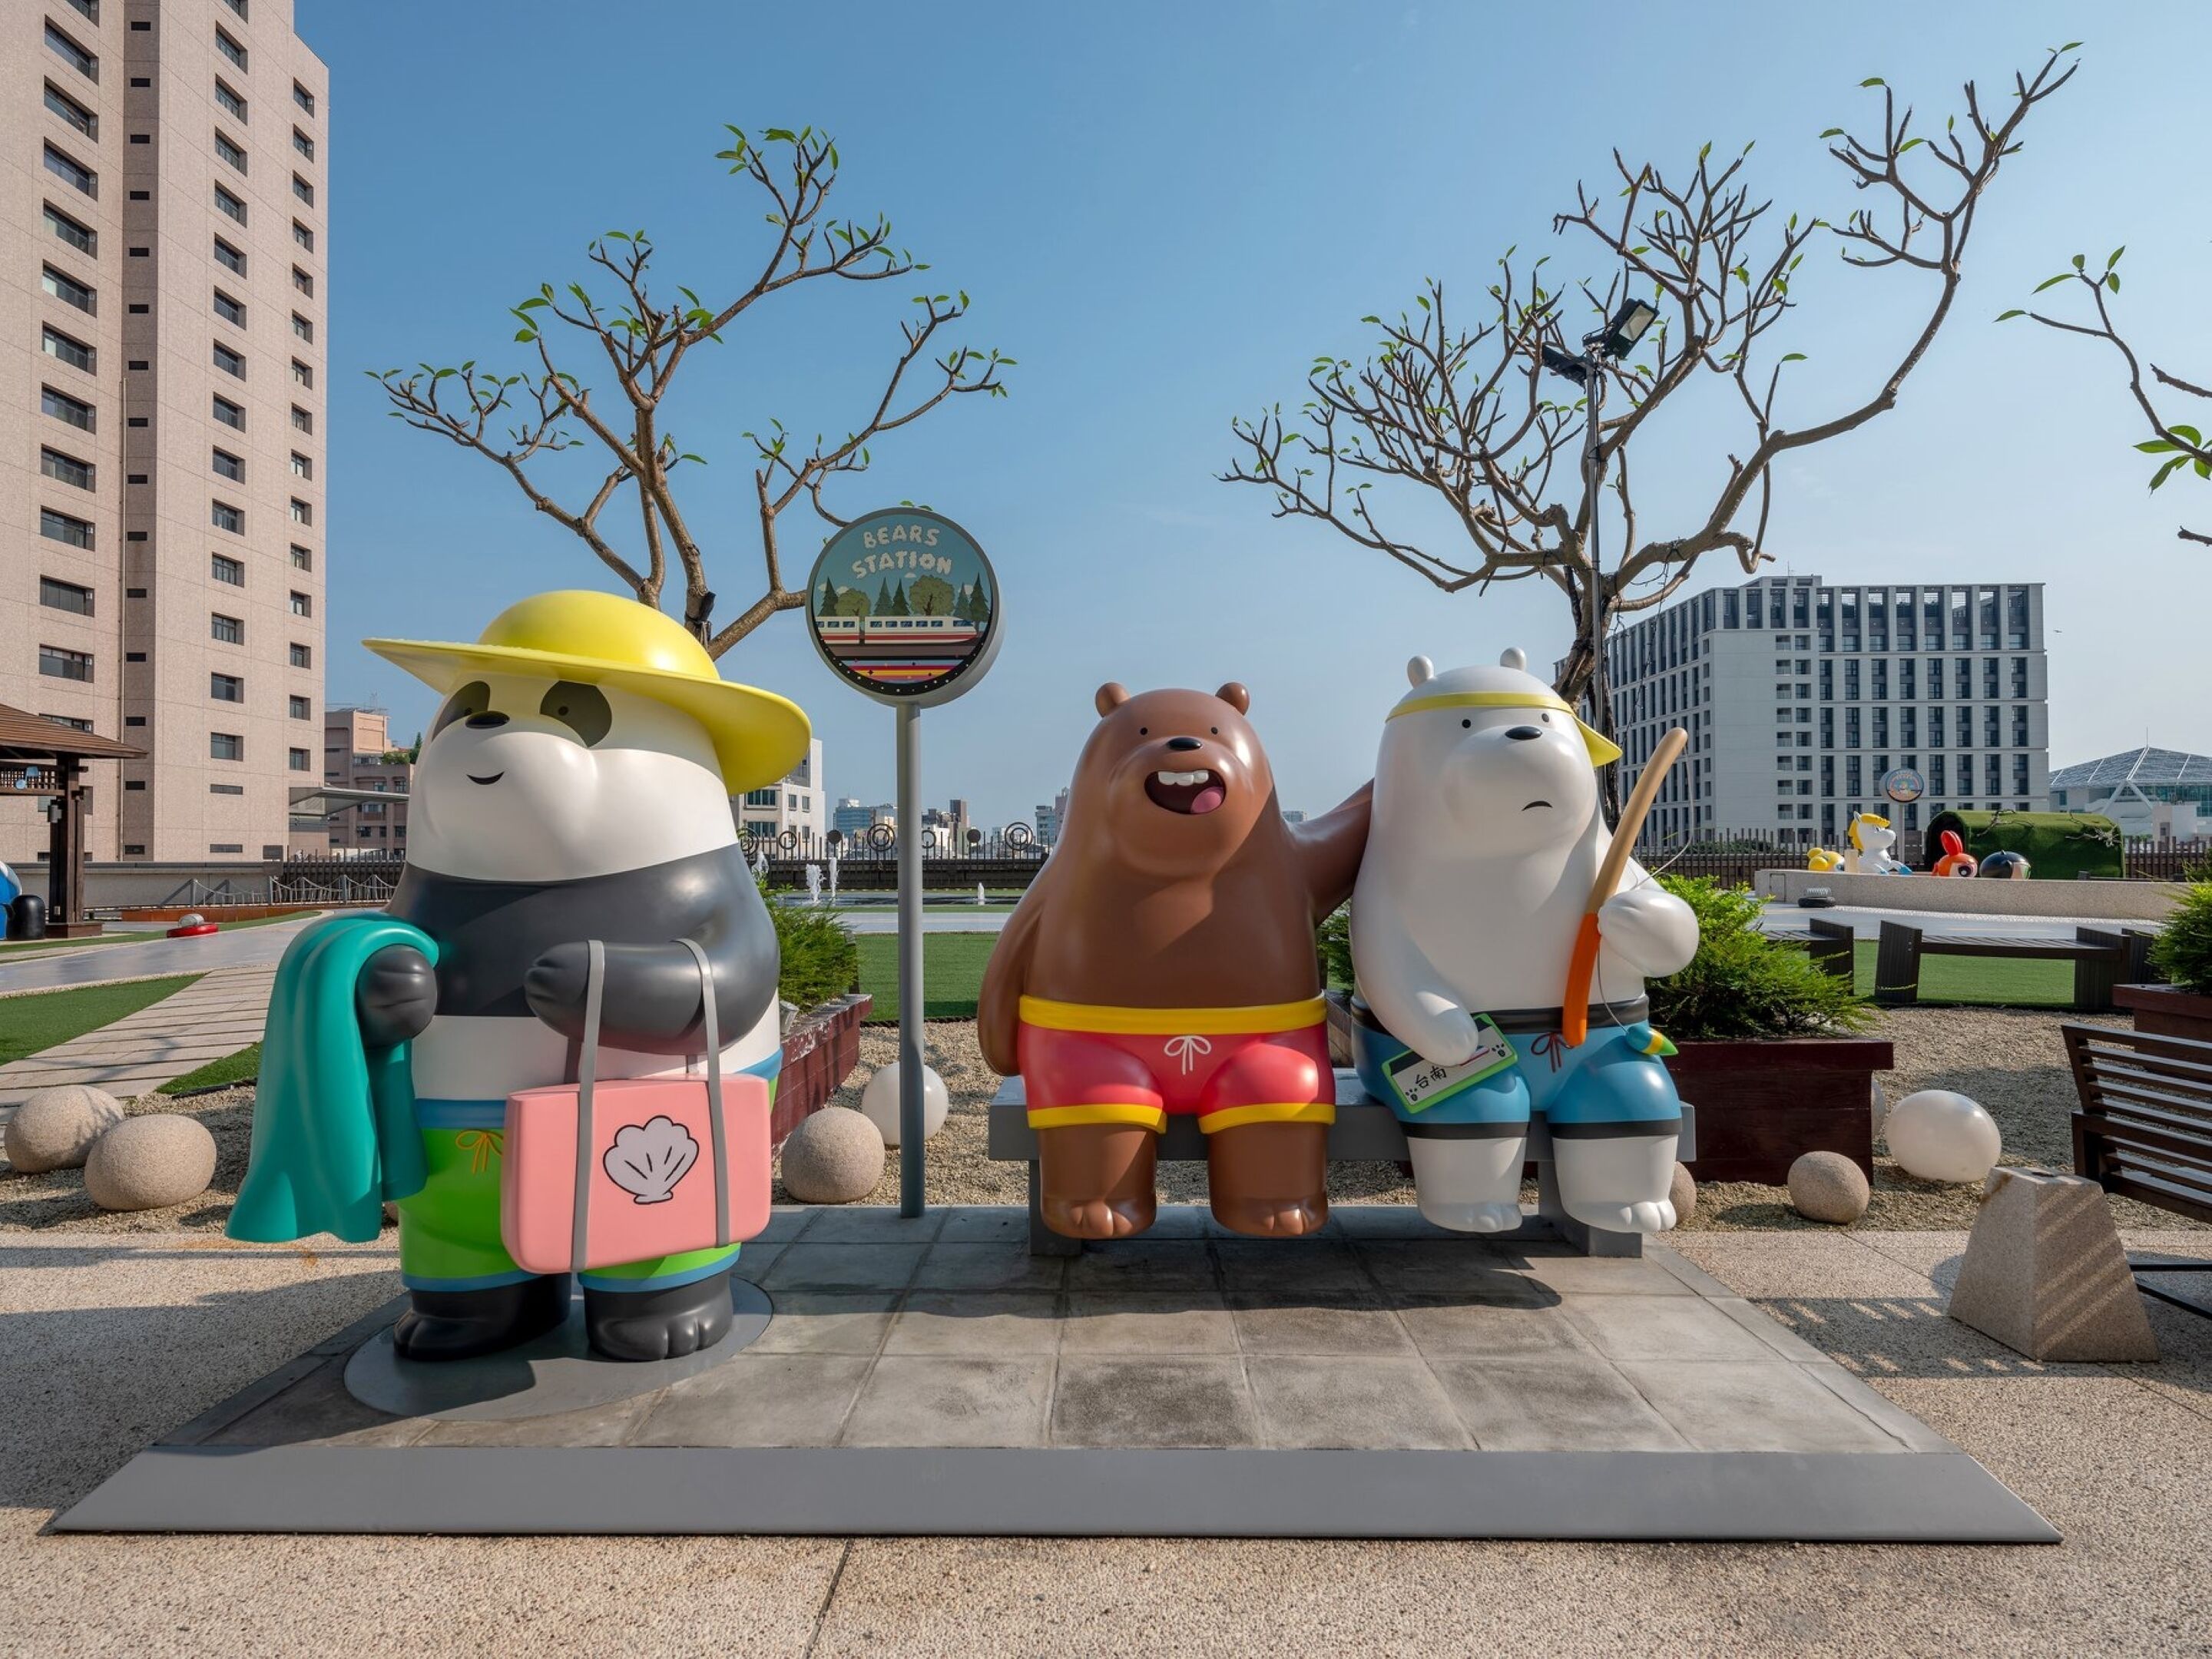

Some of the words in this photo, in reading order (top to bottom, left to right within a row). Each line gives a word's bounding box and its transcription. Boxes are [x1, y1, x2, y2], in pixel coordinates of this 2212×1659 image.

[863, 525, 940, 548] BEARS
[852, 551, 952, 579] STATION
[1416, 1065, 1447, 1089] 台南
